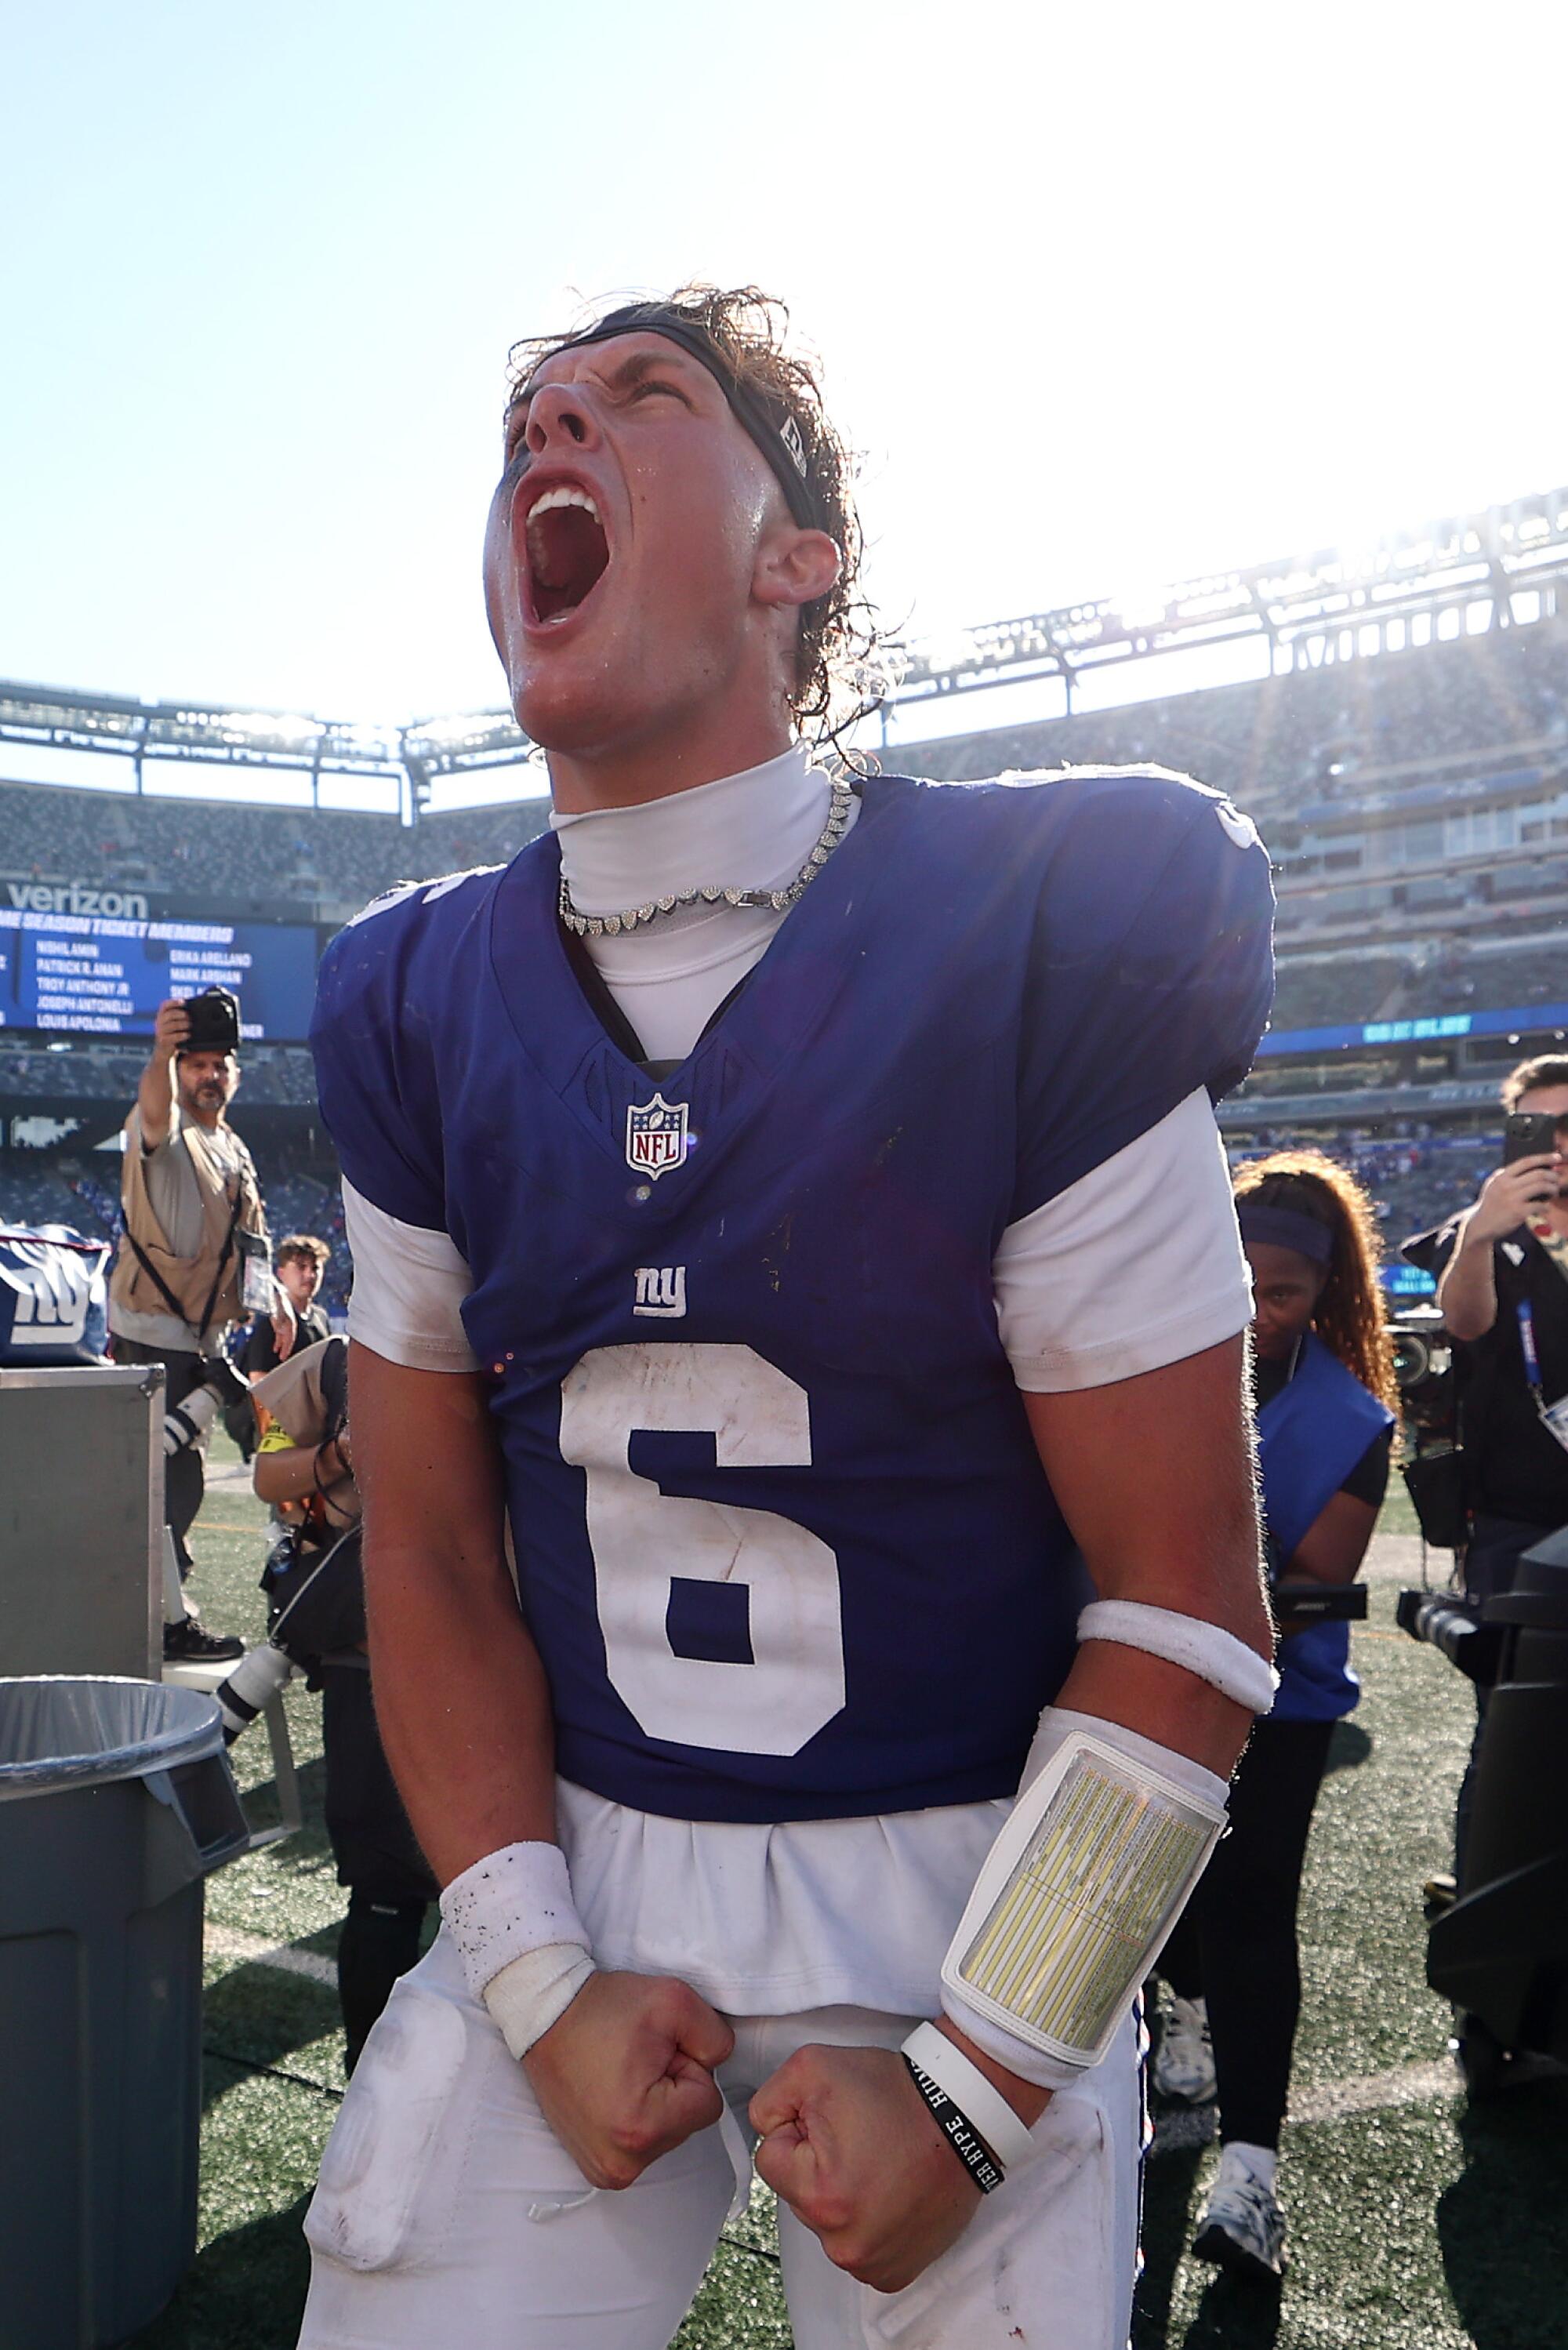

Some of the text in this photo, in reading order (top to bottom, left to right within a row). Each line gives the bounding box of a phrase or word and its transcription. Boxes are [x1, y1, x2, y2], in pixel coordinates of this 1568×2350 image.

[6, 881, 148, 920] verizon
[23, 912, 92, 935] SEASON
[93, 919, 149, 940] TICKET
[148, 922, 234, 944] MEMBERS
[36, 957, 82, 975] PATRICK
[170, 968, 200, 982] MARK
[36, 977, 65, 991] TROY
[66, 979, 116, 995] ANTHONY
[36, 995, 134, 1015] JOSEPH ANTONELLI
[36, 1013, 68, 1030] LOUIS
[635, 1134, 677, 1164] NFL
[633, 1266, 687, 1319] ny
[559, 1342, 847, 1757] 6
[945, 2115, 983, 2166] HYPE
